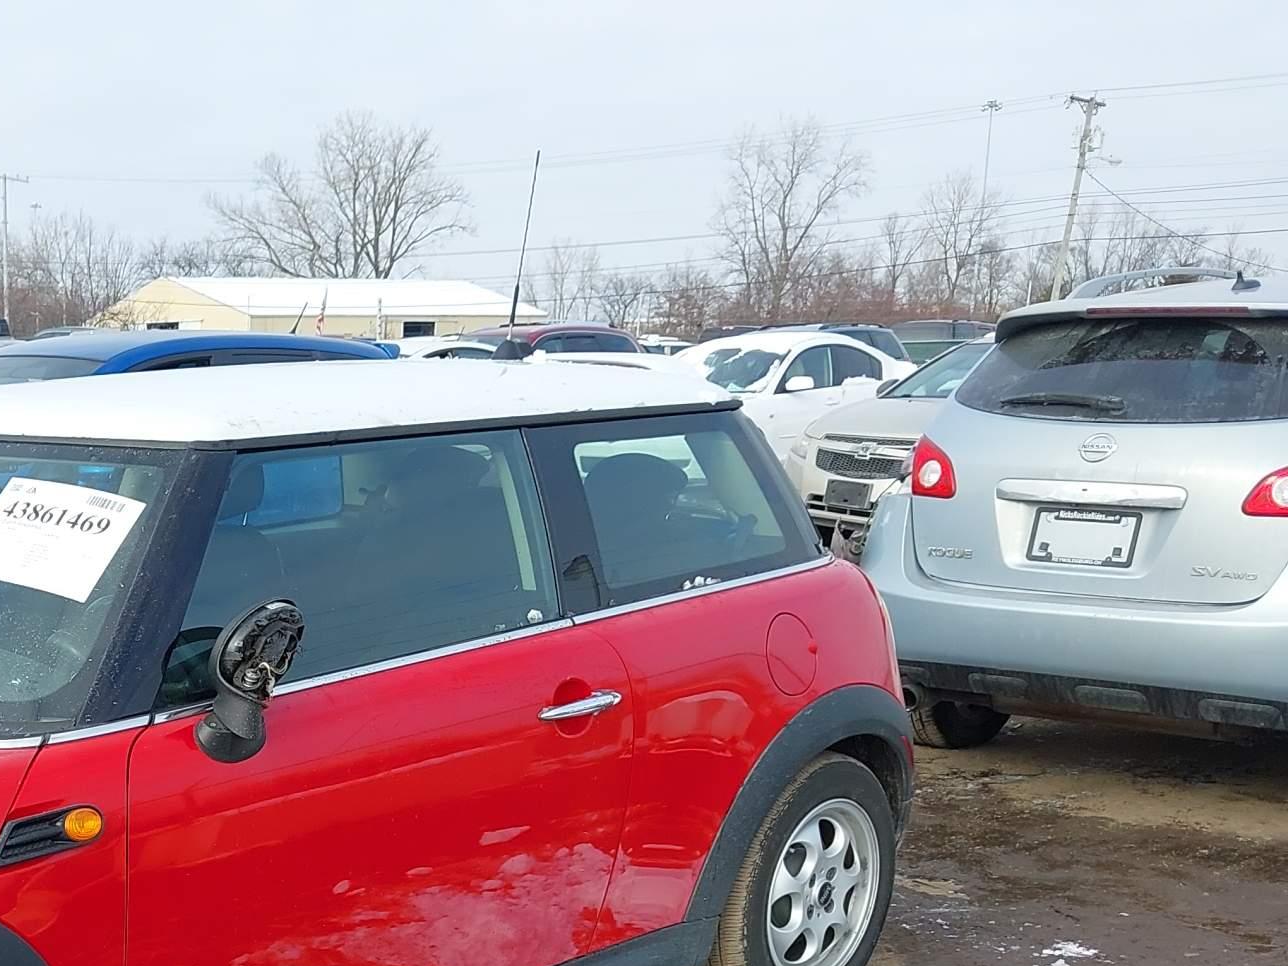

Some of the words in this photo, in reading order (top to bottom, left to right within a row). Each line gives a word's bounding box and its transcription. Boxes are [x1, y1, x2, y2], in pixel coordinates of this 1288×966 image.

[3, 500, 111, 535] 43861469
[927, 546, 973, 560] ROGUE
[1190, 565, 1223, 579] SV
[1220, 571, 1258, 581] AWD
